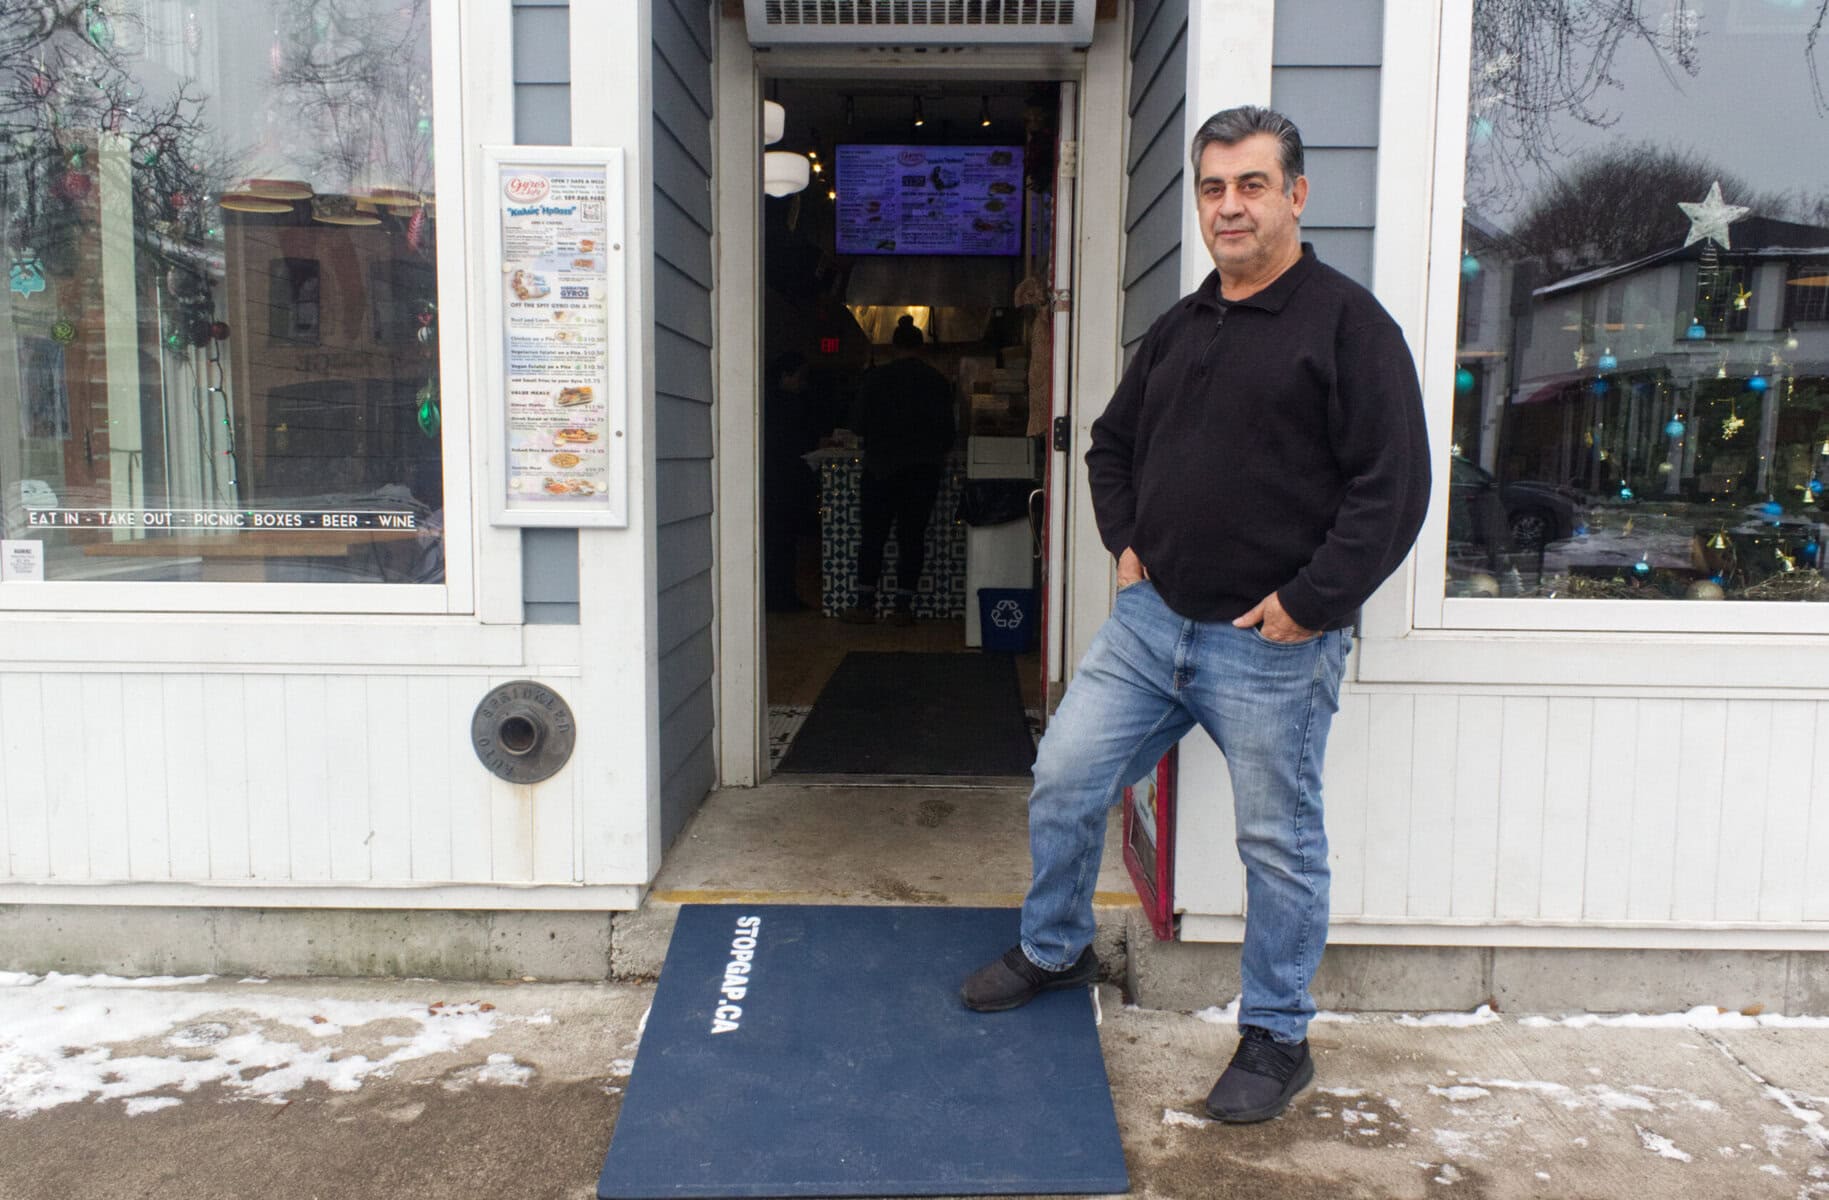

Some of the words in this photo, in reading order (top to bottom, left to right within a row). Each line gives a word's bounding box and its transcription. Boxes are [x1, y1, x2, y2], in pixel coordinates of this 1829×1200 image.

[29, 512, 57, 525] EAT
[64, 512, 79, 525] IN
[100, 512, 135, 525] TAKE
[143, 513, 172, 525] OUT
[194, 513, 245, 526] PICNIC
[254, 513, 302, 527] BOXES
[322, 514, 358, 527] BEER
[378, 515, 415, 528] WINE
[711, 916, 761, 1034] STOPGAP.CA
